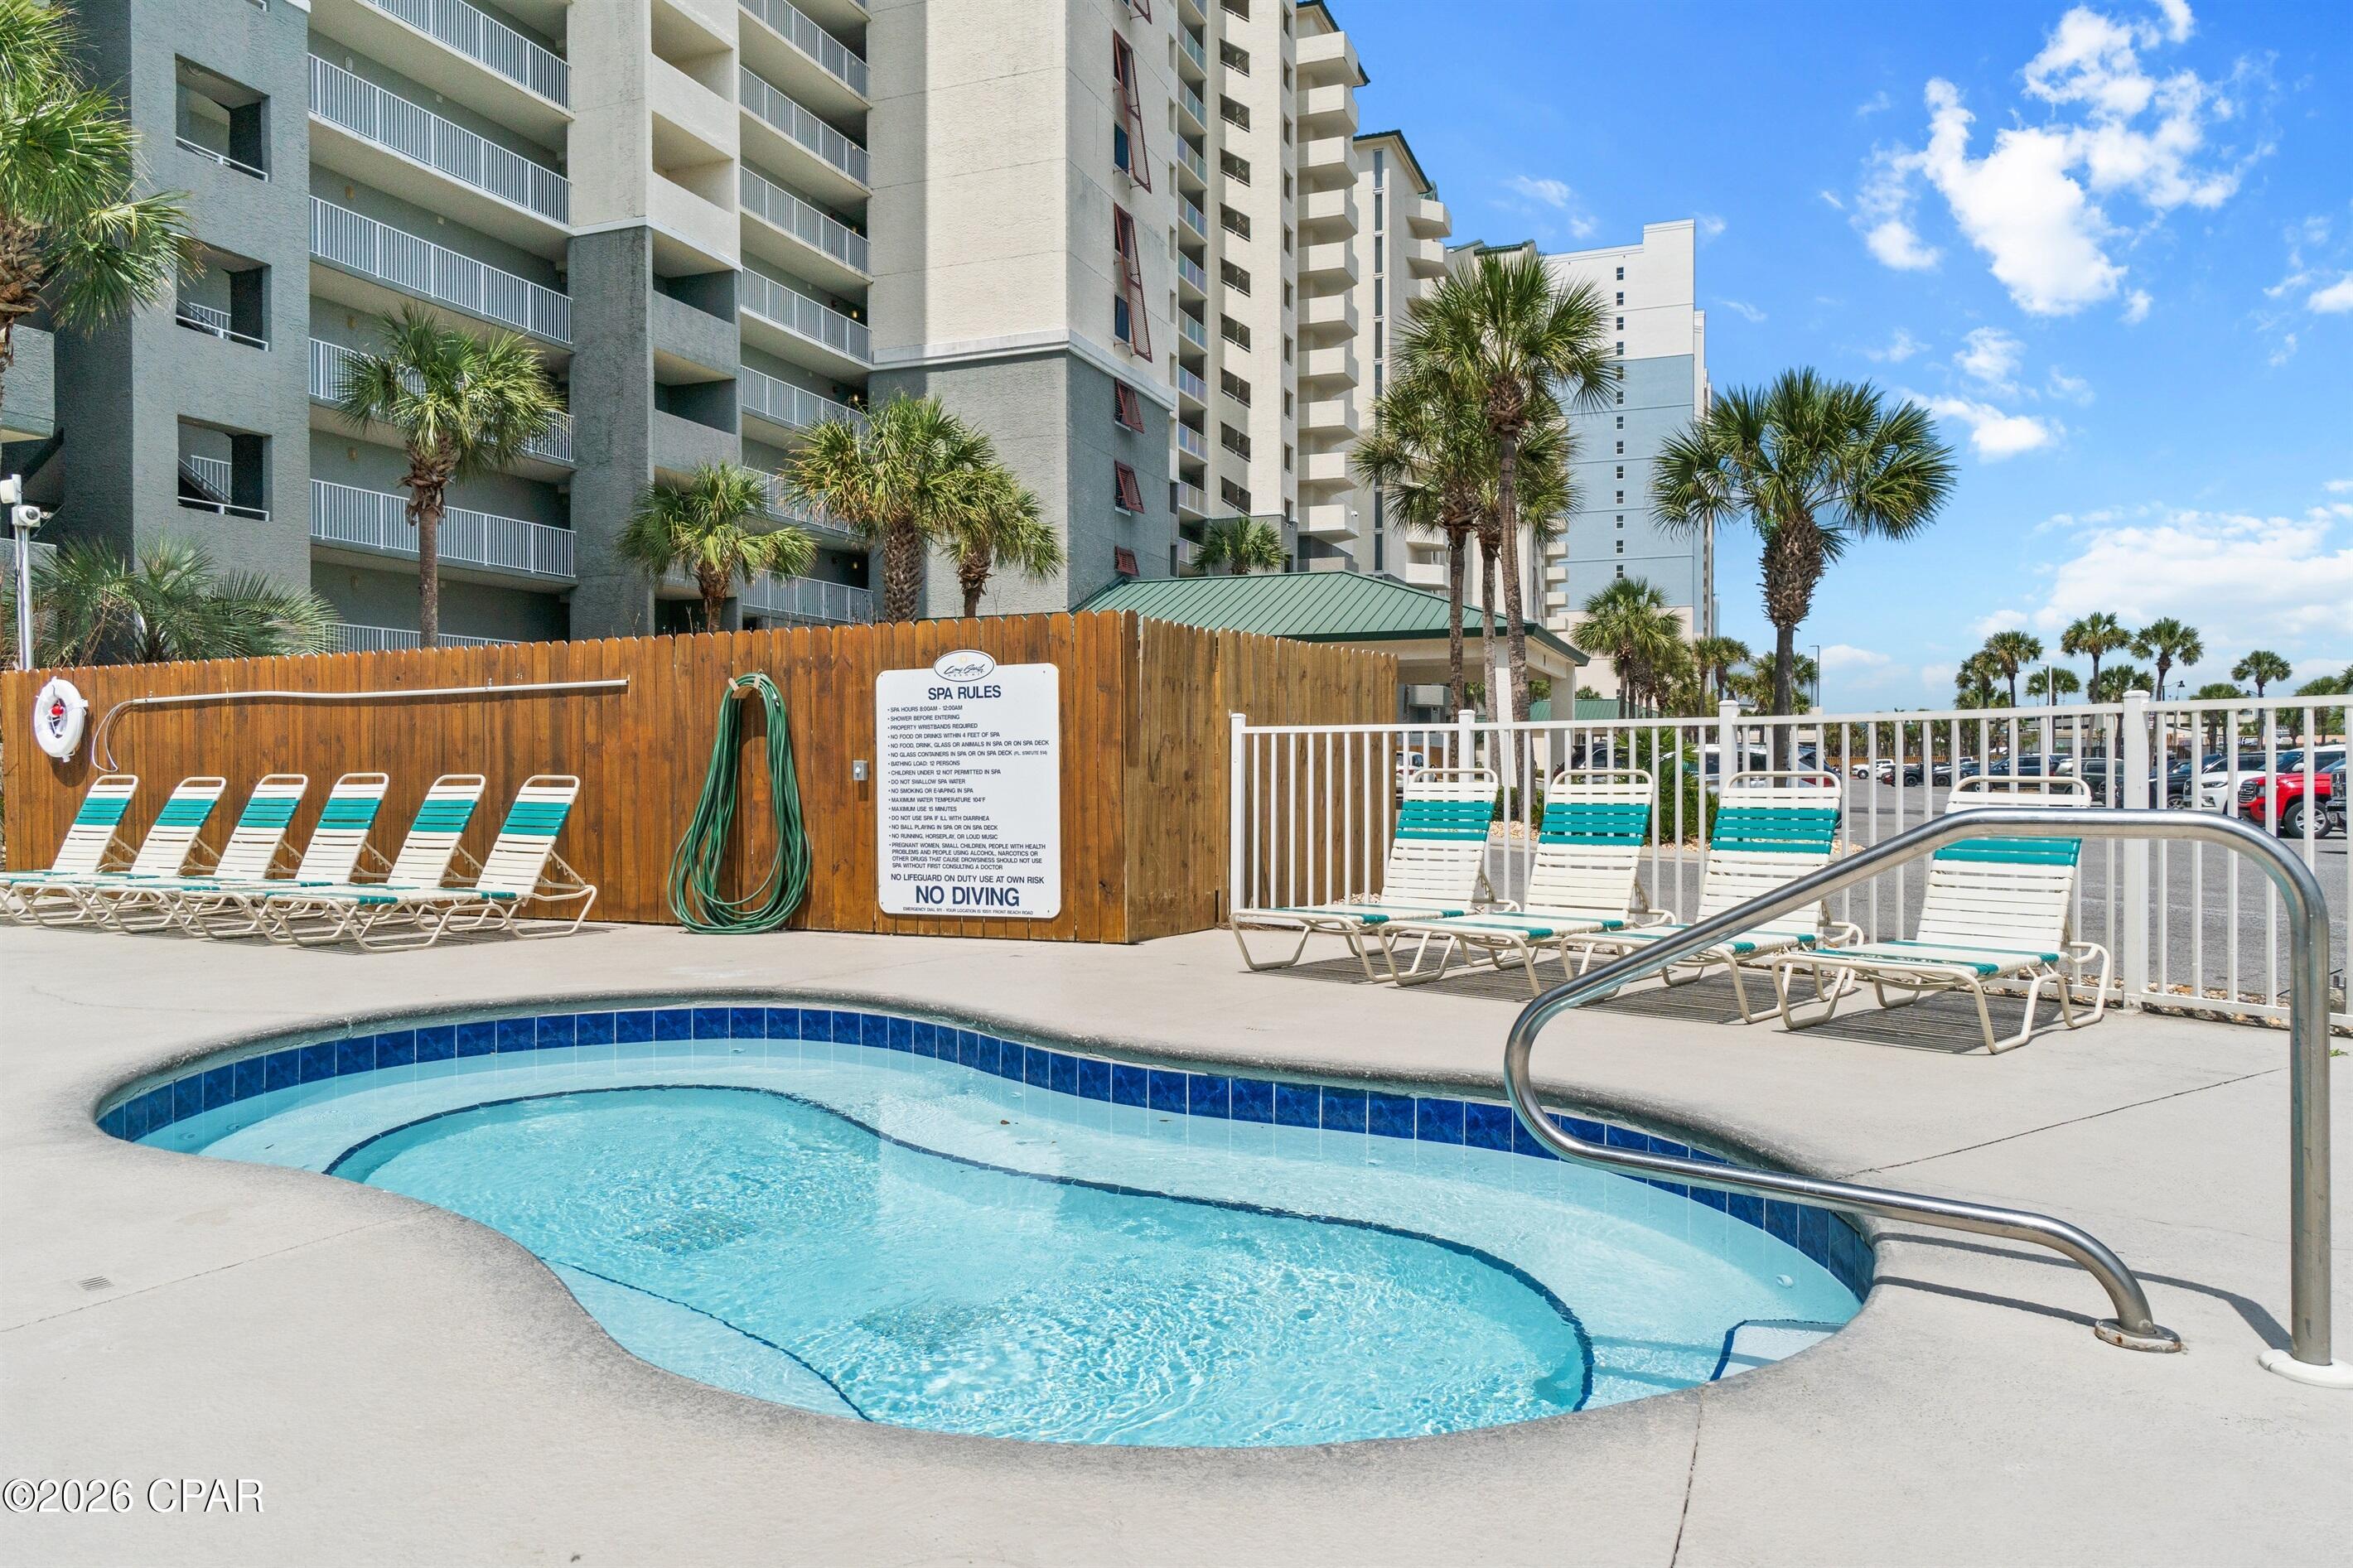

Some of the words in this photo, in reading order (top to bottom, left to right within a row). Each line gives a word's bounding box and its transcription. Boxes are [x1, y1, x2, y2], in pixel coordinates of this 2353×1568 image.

[928, 687, 953, 700] SPA
[958, 685, 1001, 699] RULES
[904, 874, 942, 882] LIFEGUARD
[916, 885, 944, 904] NO
[952, 887, 1019, 906] DIVING
